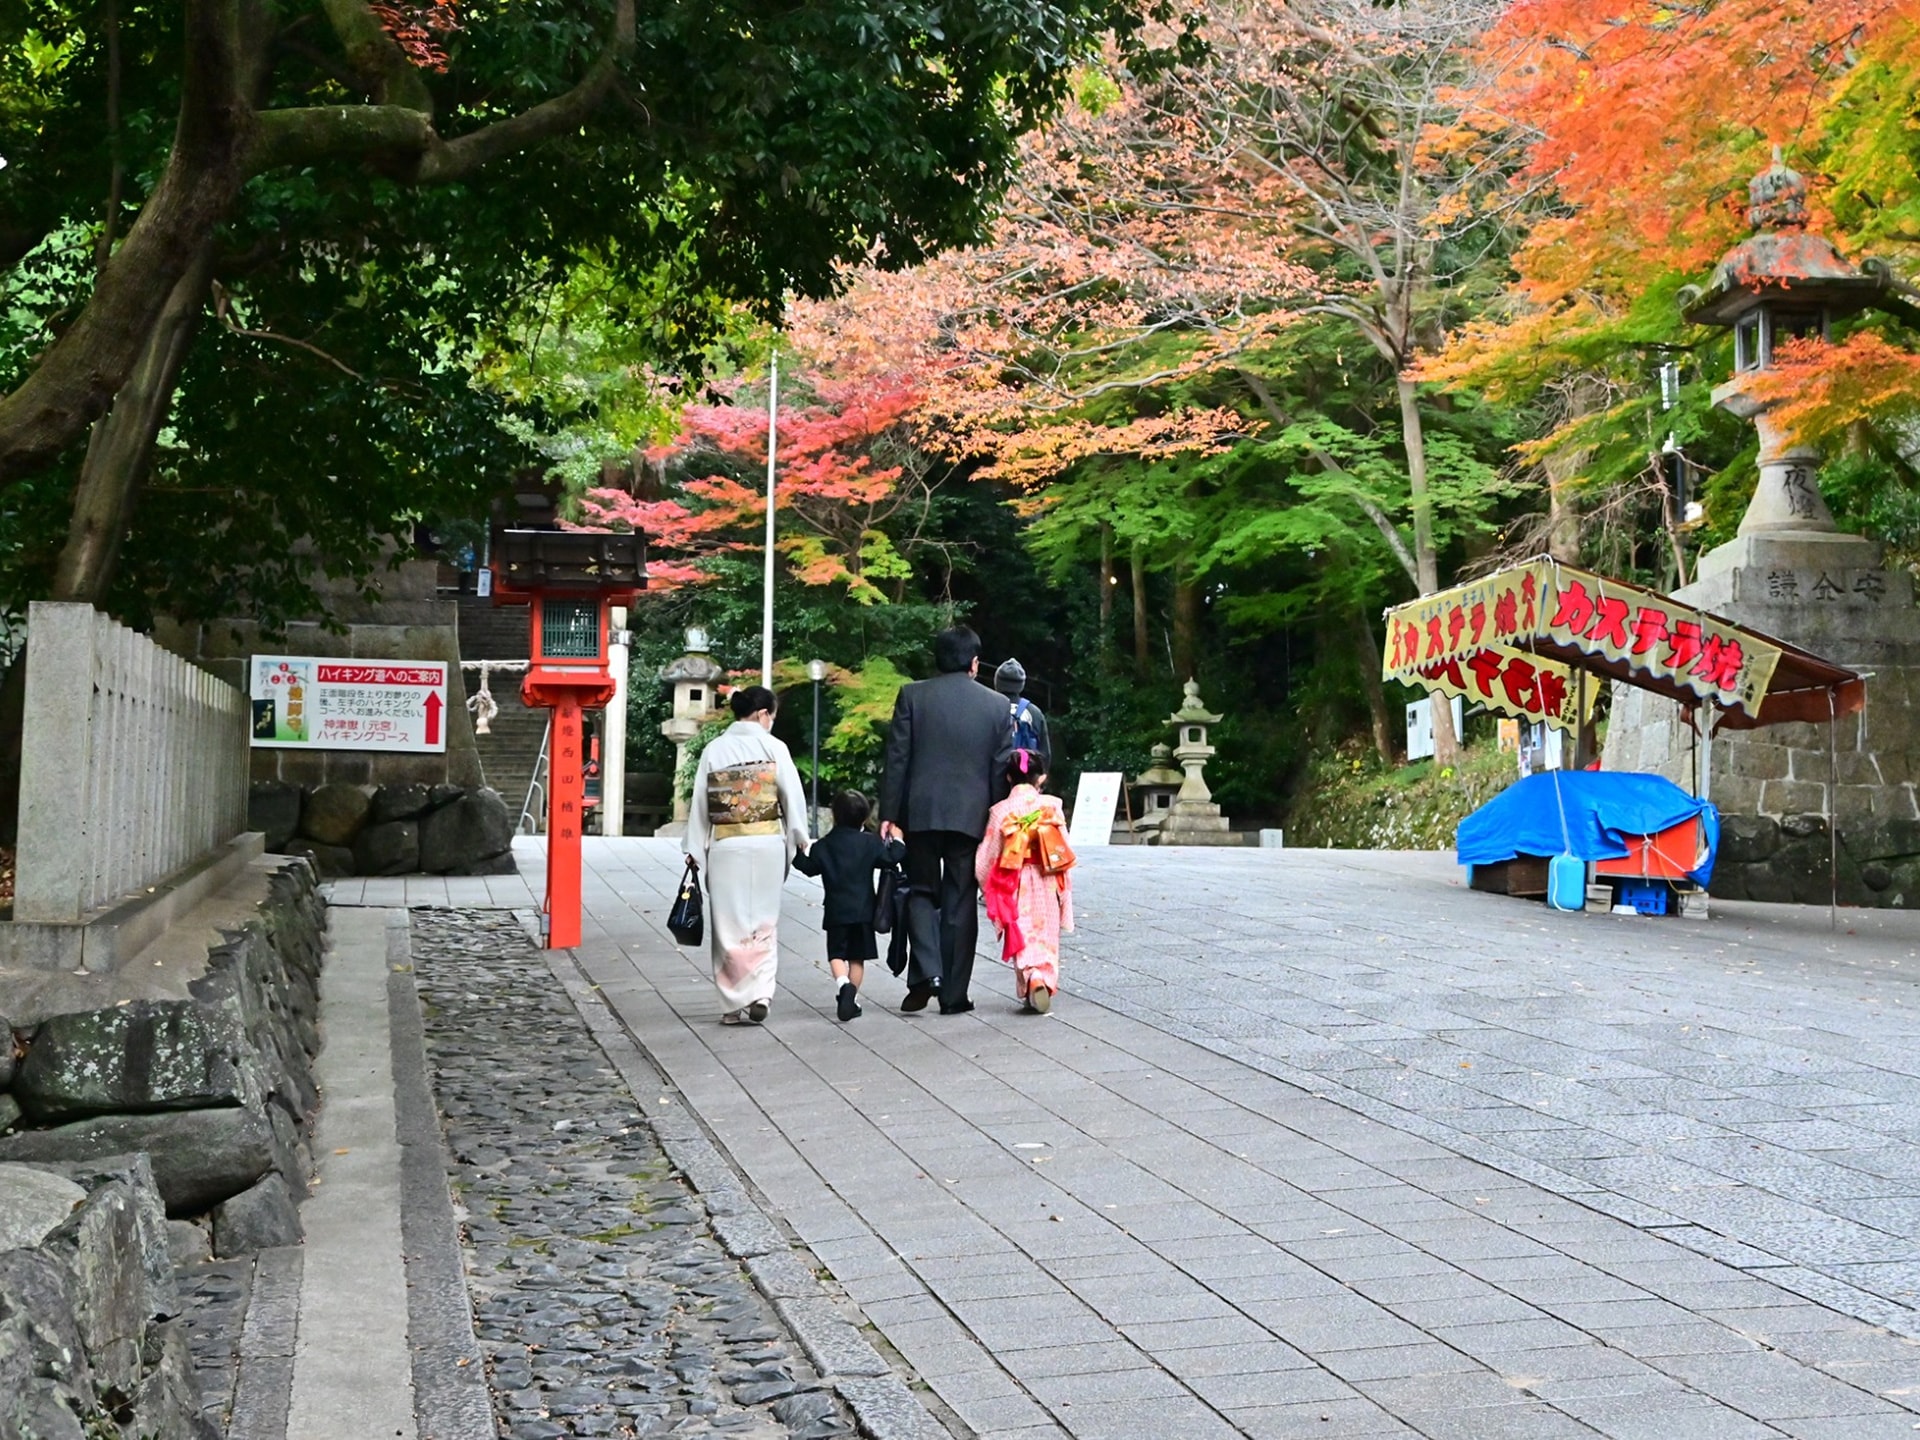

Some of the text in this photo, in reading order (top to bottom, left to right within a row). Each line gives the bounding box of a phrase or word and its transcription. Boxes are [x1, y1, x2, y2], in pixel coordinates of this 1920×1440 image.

[1404, 588, 1518, 667] カステラ焼
[1550, 580, 1745, 692] カステラ焼
[319, 666, 441, 685] ハイキング道へのご案内
[317, 731, 409, 743] ハイキングコース
